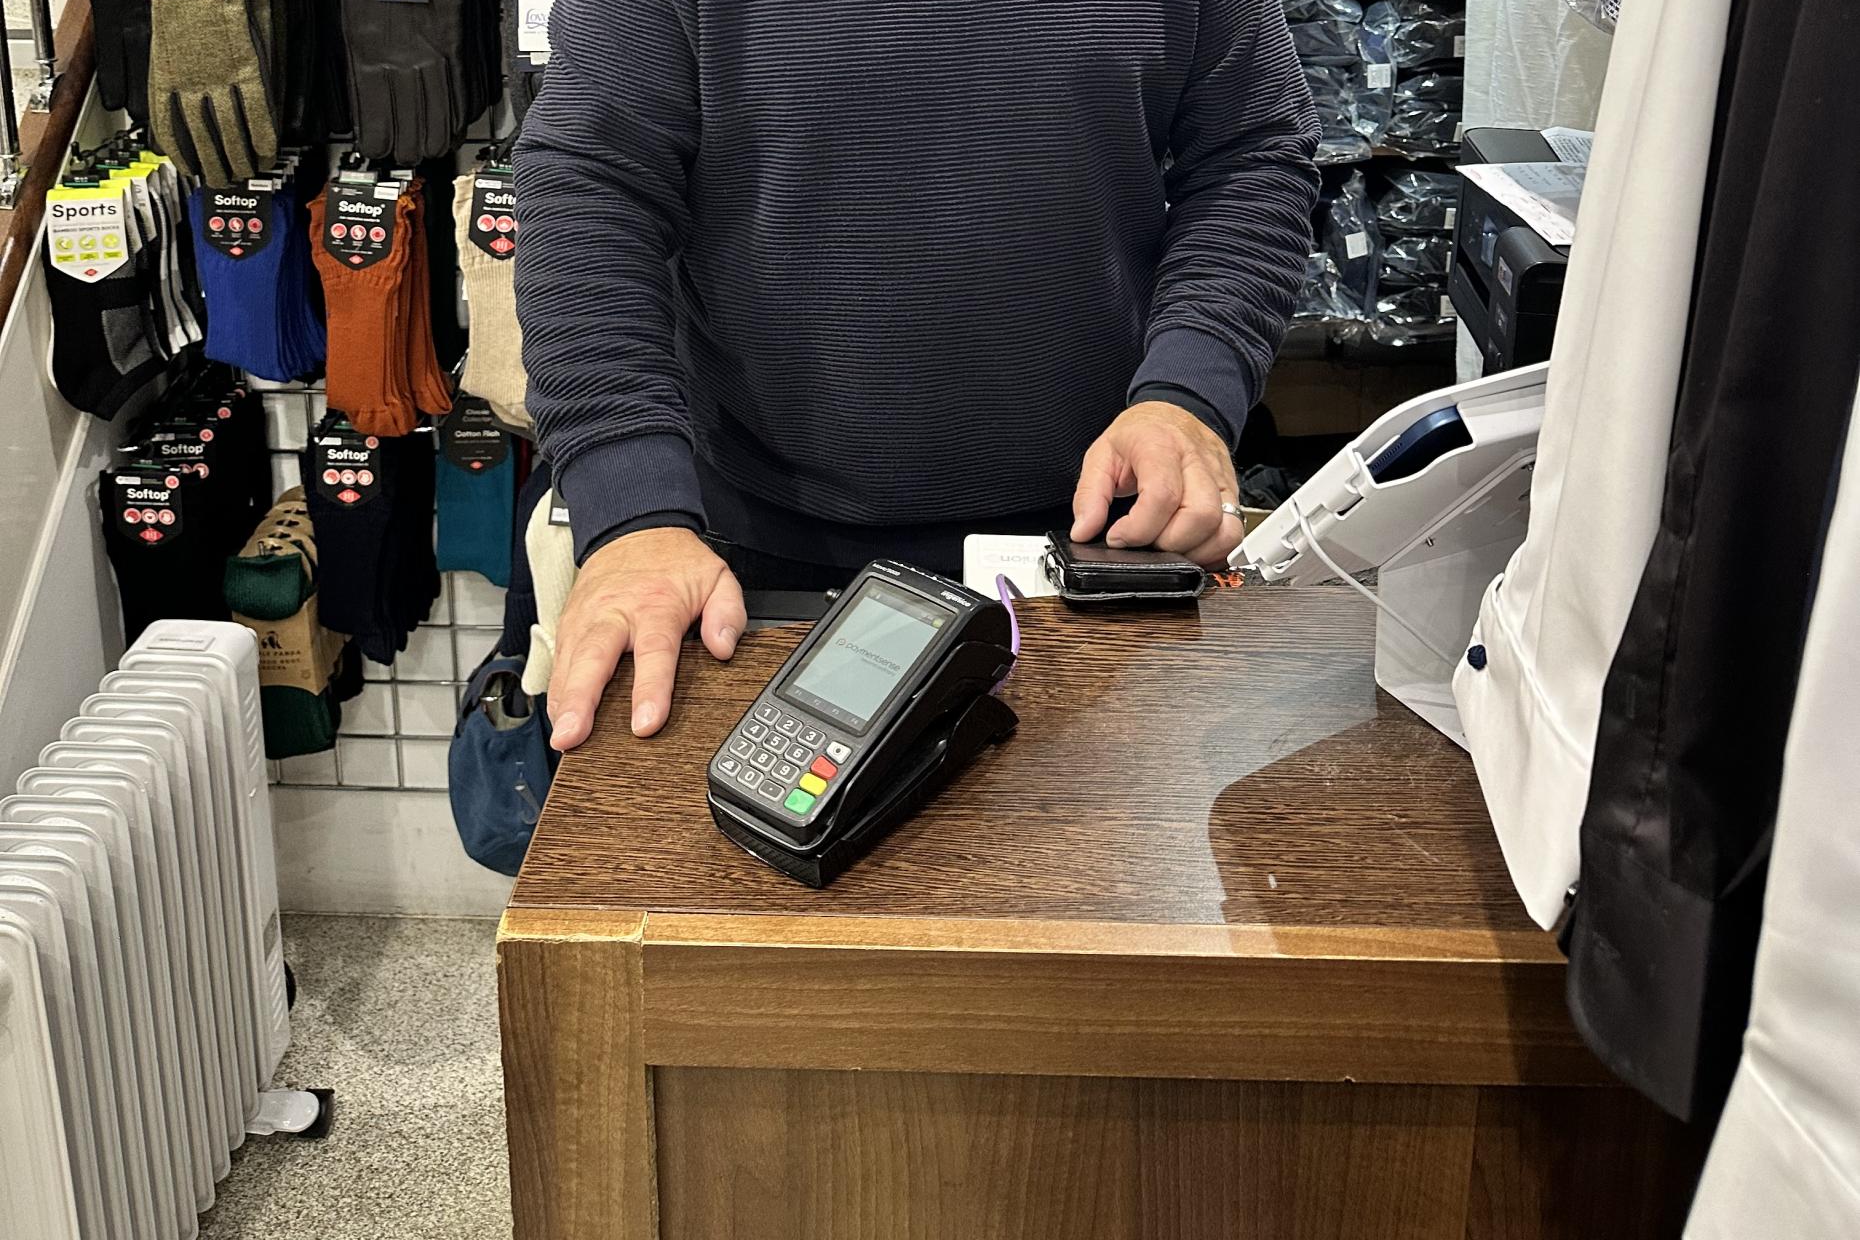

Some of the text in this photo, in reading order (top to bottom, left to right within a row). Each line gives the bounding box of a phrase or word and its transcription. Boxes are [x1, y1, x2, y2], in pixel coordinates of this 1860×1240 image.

[214, 194, 258, 209] Softop
[338, 200, 383, 217] Softop
[52, 203, 117, 221] Sports
[454, 430, 481, 438] Cotton
[162, 444, 204, 455] Softop
[327, 448, 369, 462] Softop
[126, 488, 170, 501] Softop
[845, 640, 901, 672] paymentsense
[764, 708, 816, 741] 1 2 3
[749, 724, 803, 759] 4 5 6
[737, 741, 790, 776] 7 8 9
[744, 770, 754, 781] 0
